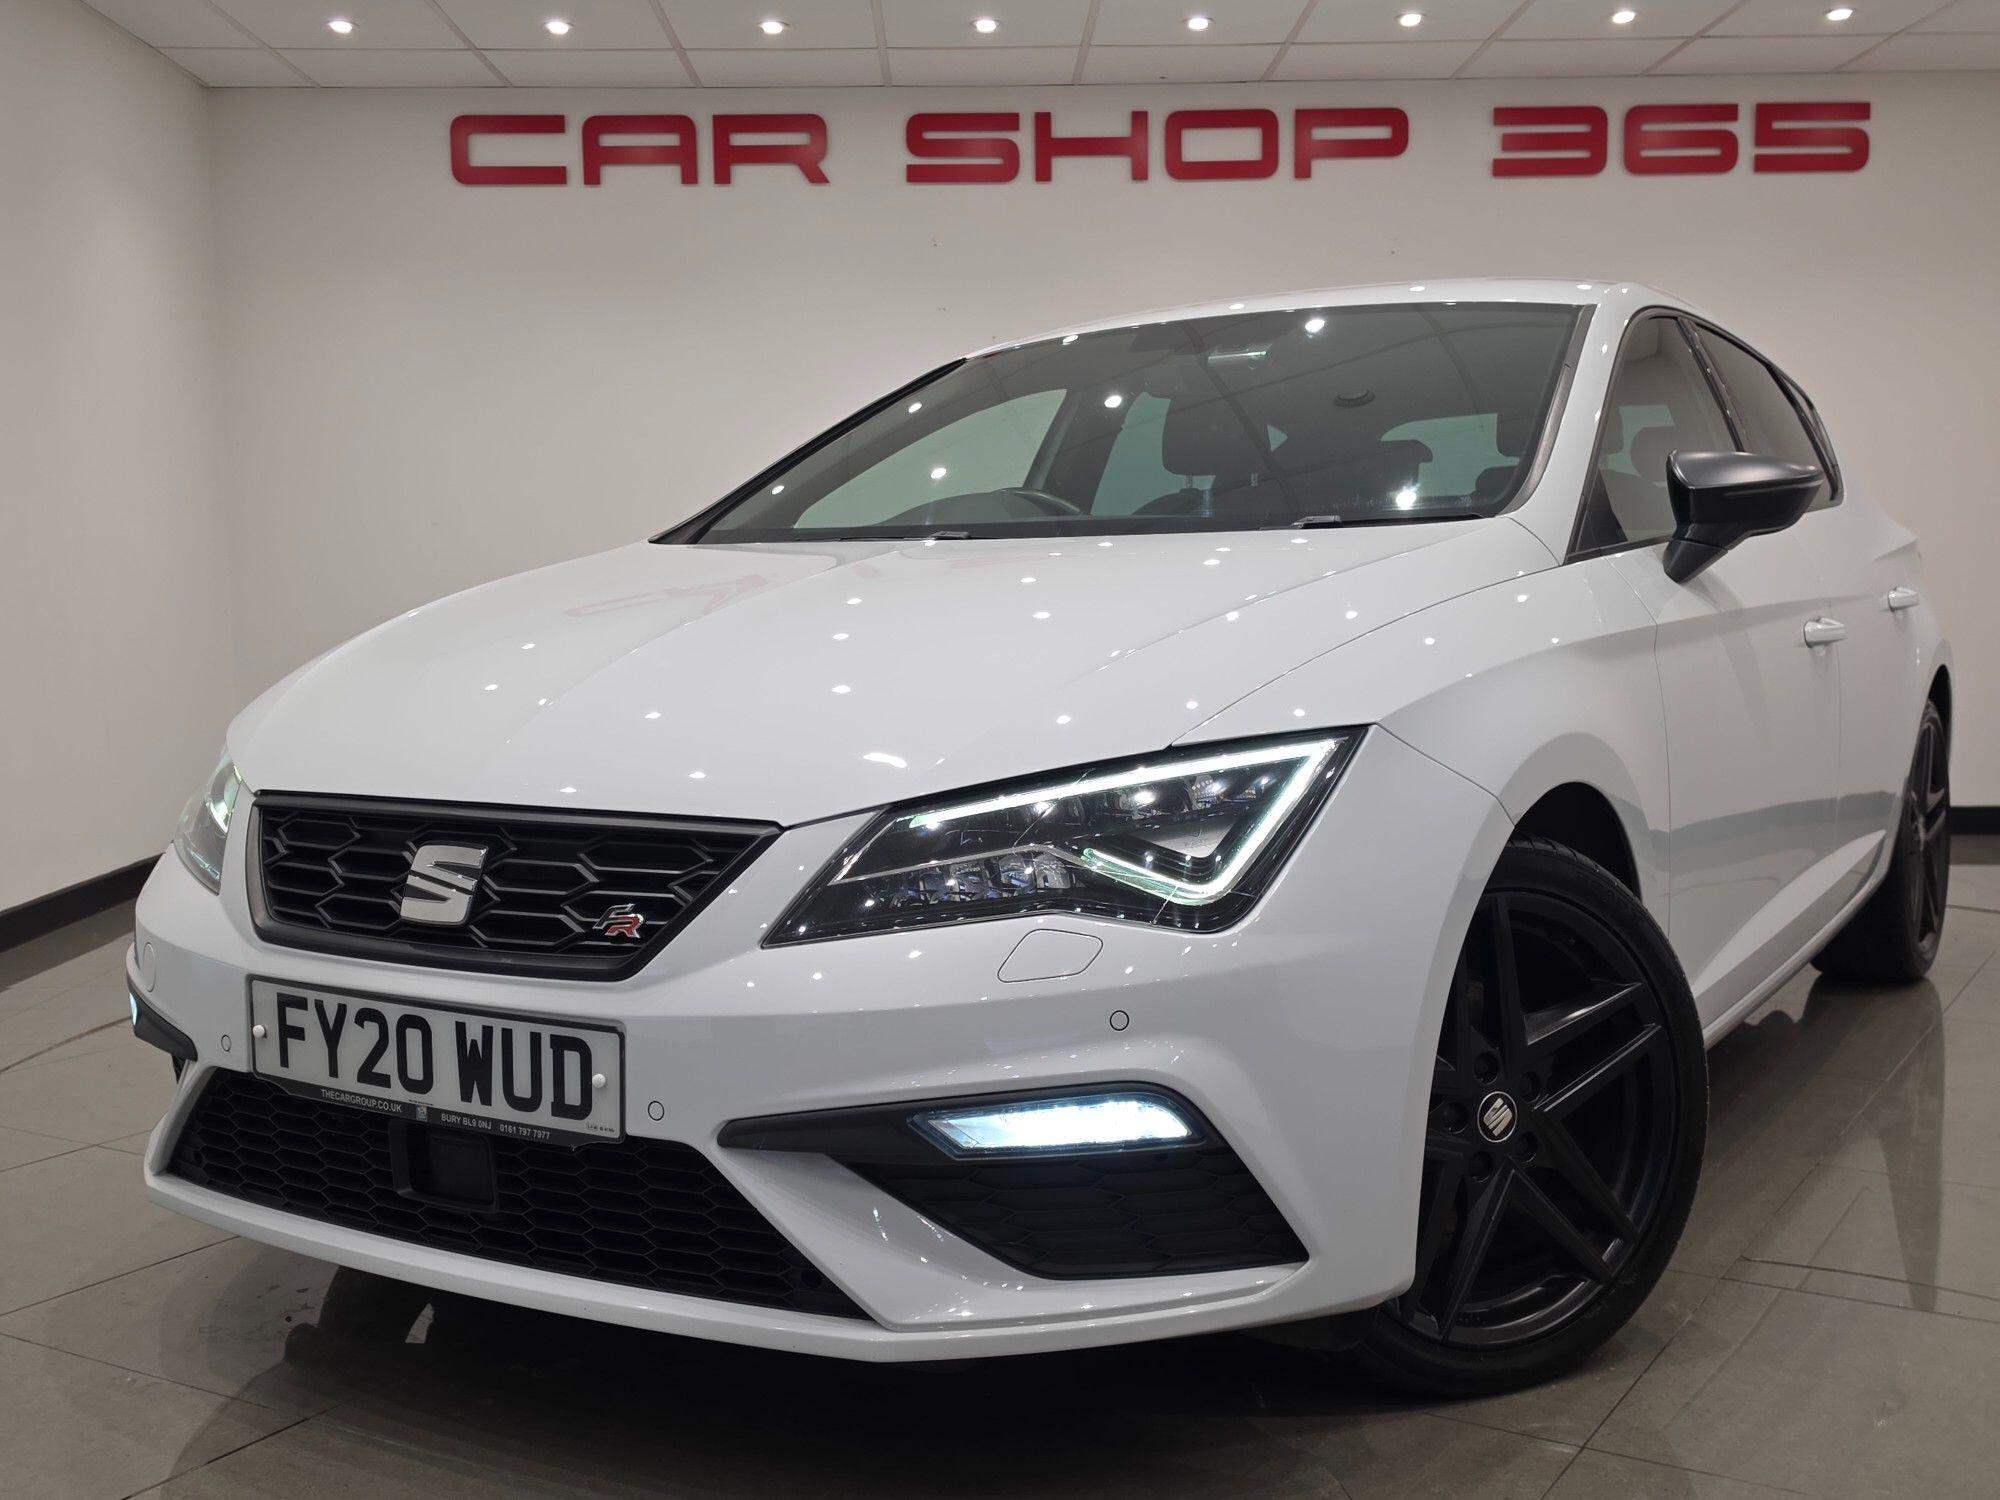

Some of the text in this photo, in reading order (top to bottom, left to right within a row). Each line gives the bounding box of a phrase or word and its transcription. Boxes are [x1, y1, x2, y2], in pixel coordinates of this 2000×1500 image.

[449, 101, 1871, 185] CAR SHOP 365
[276, 992, 593, 1121] FY20 WUD
[320, 1089, 402, 1112] THECARGROUP.CO.UK
[441, 1113, 462, 1124] BURY
[463, 1117, 476, 1127] BL9
[500, 1123, 516, 1134] 0161
[518, 1126, 531, 1136] 797
[533, 1129, 550, 1140] 7977
